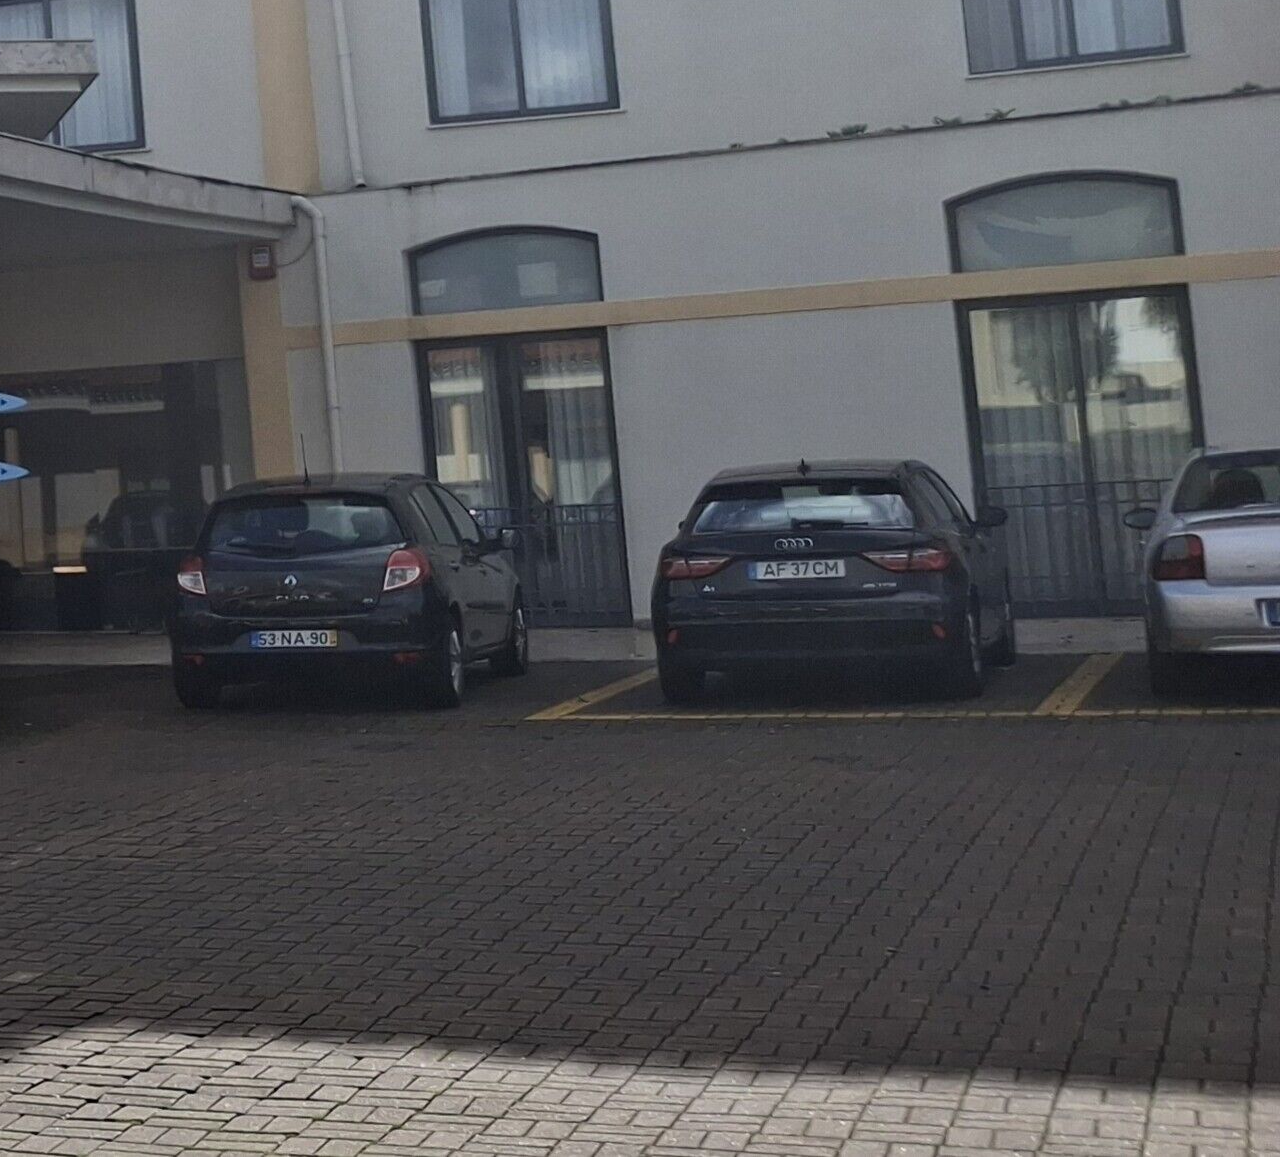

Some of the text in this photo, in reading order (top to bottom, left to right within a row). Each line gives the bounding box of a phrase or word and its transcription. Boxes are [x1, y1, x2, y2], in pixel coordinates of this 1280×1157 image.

[763, 561, 838, 577] AF 37 CM
